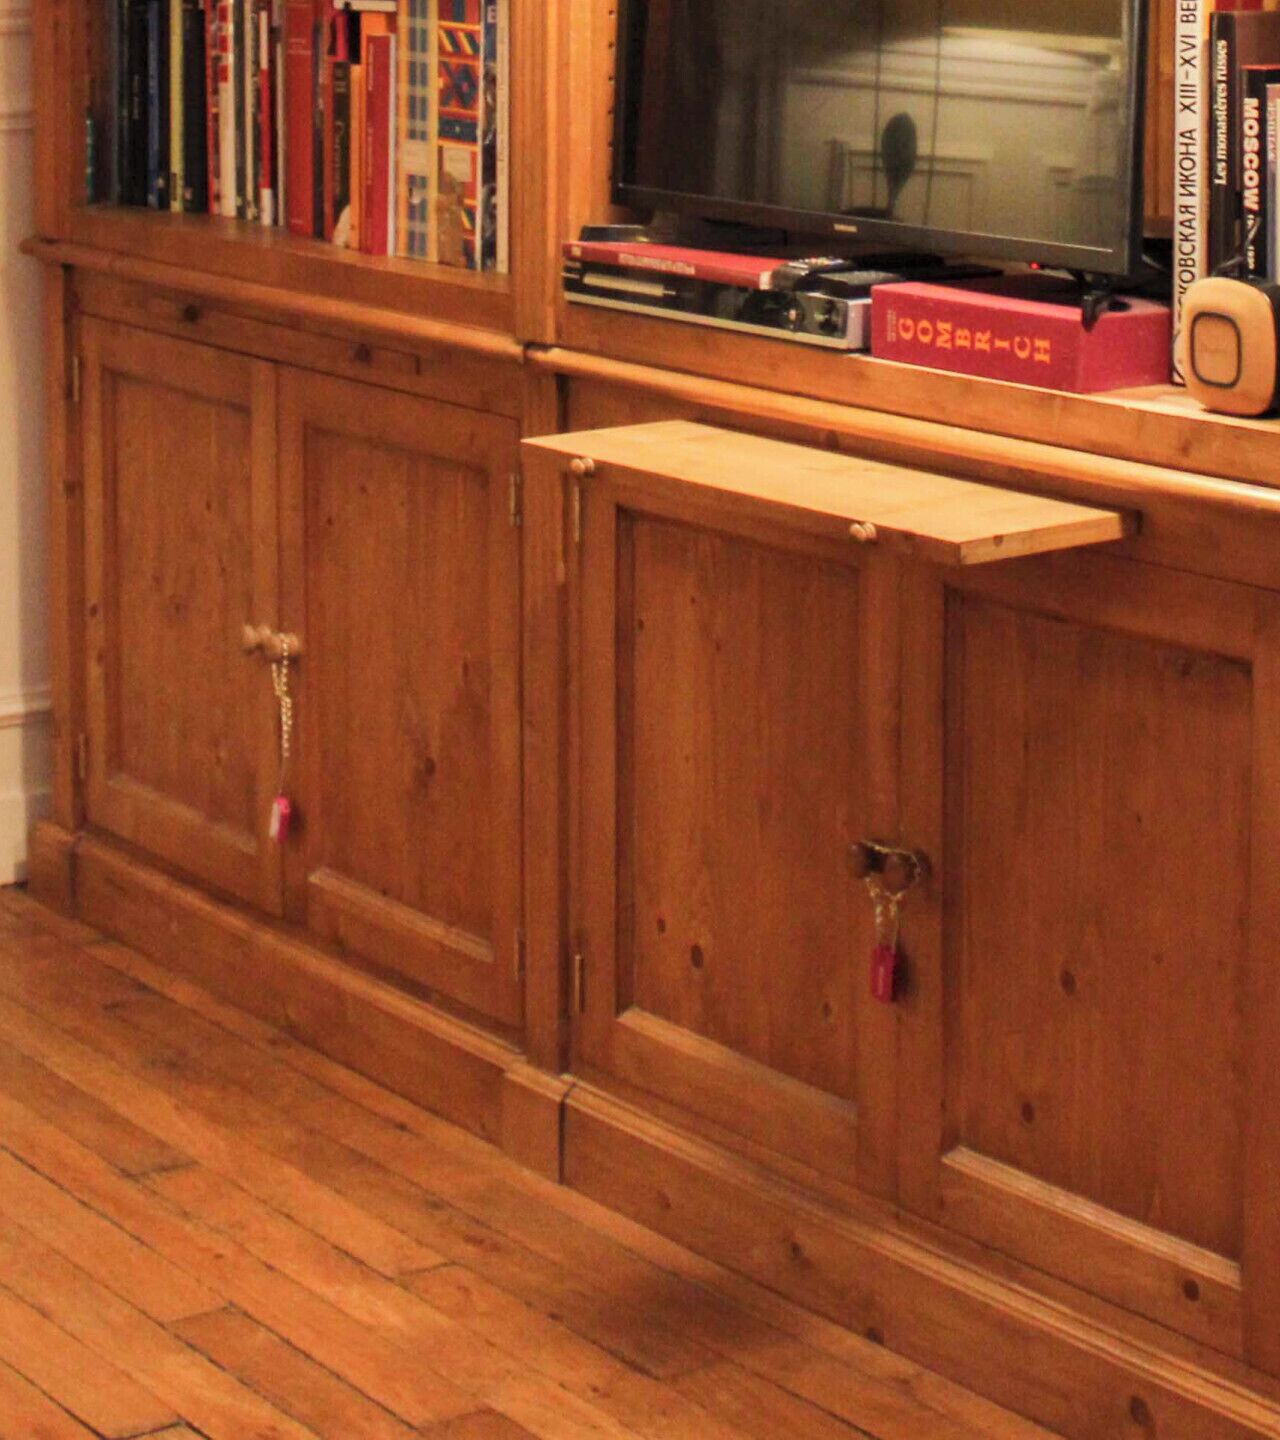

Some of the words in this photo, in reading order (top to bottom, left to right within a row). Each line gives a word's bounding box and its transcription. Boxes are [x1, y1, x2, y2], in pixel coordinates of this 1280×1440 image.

[1216, 39, 1229, 81] russes
[1213, 83, 1228, 160] monastères
[1179, 128, 1198, 198] ИКОНА
[1214, 161, 1228, 185] Les
[1242, 97, 1261, 211] MOSCOW
[897, 316, 1052, 366] GOMBRICH
